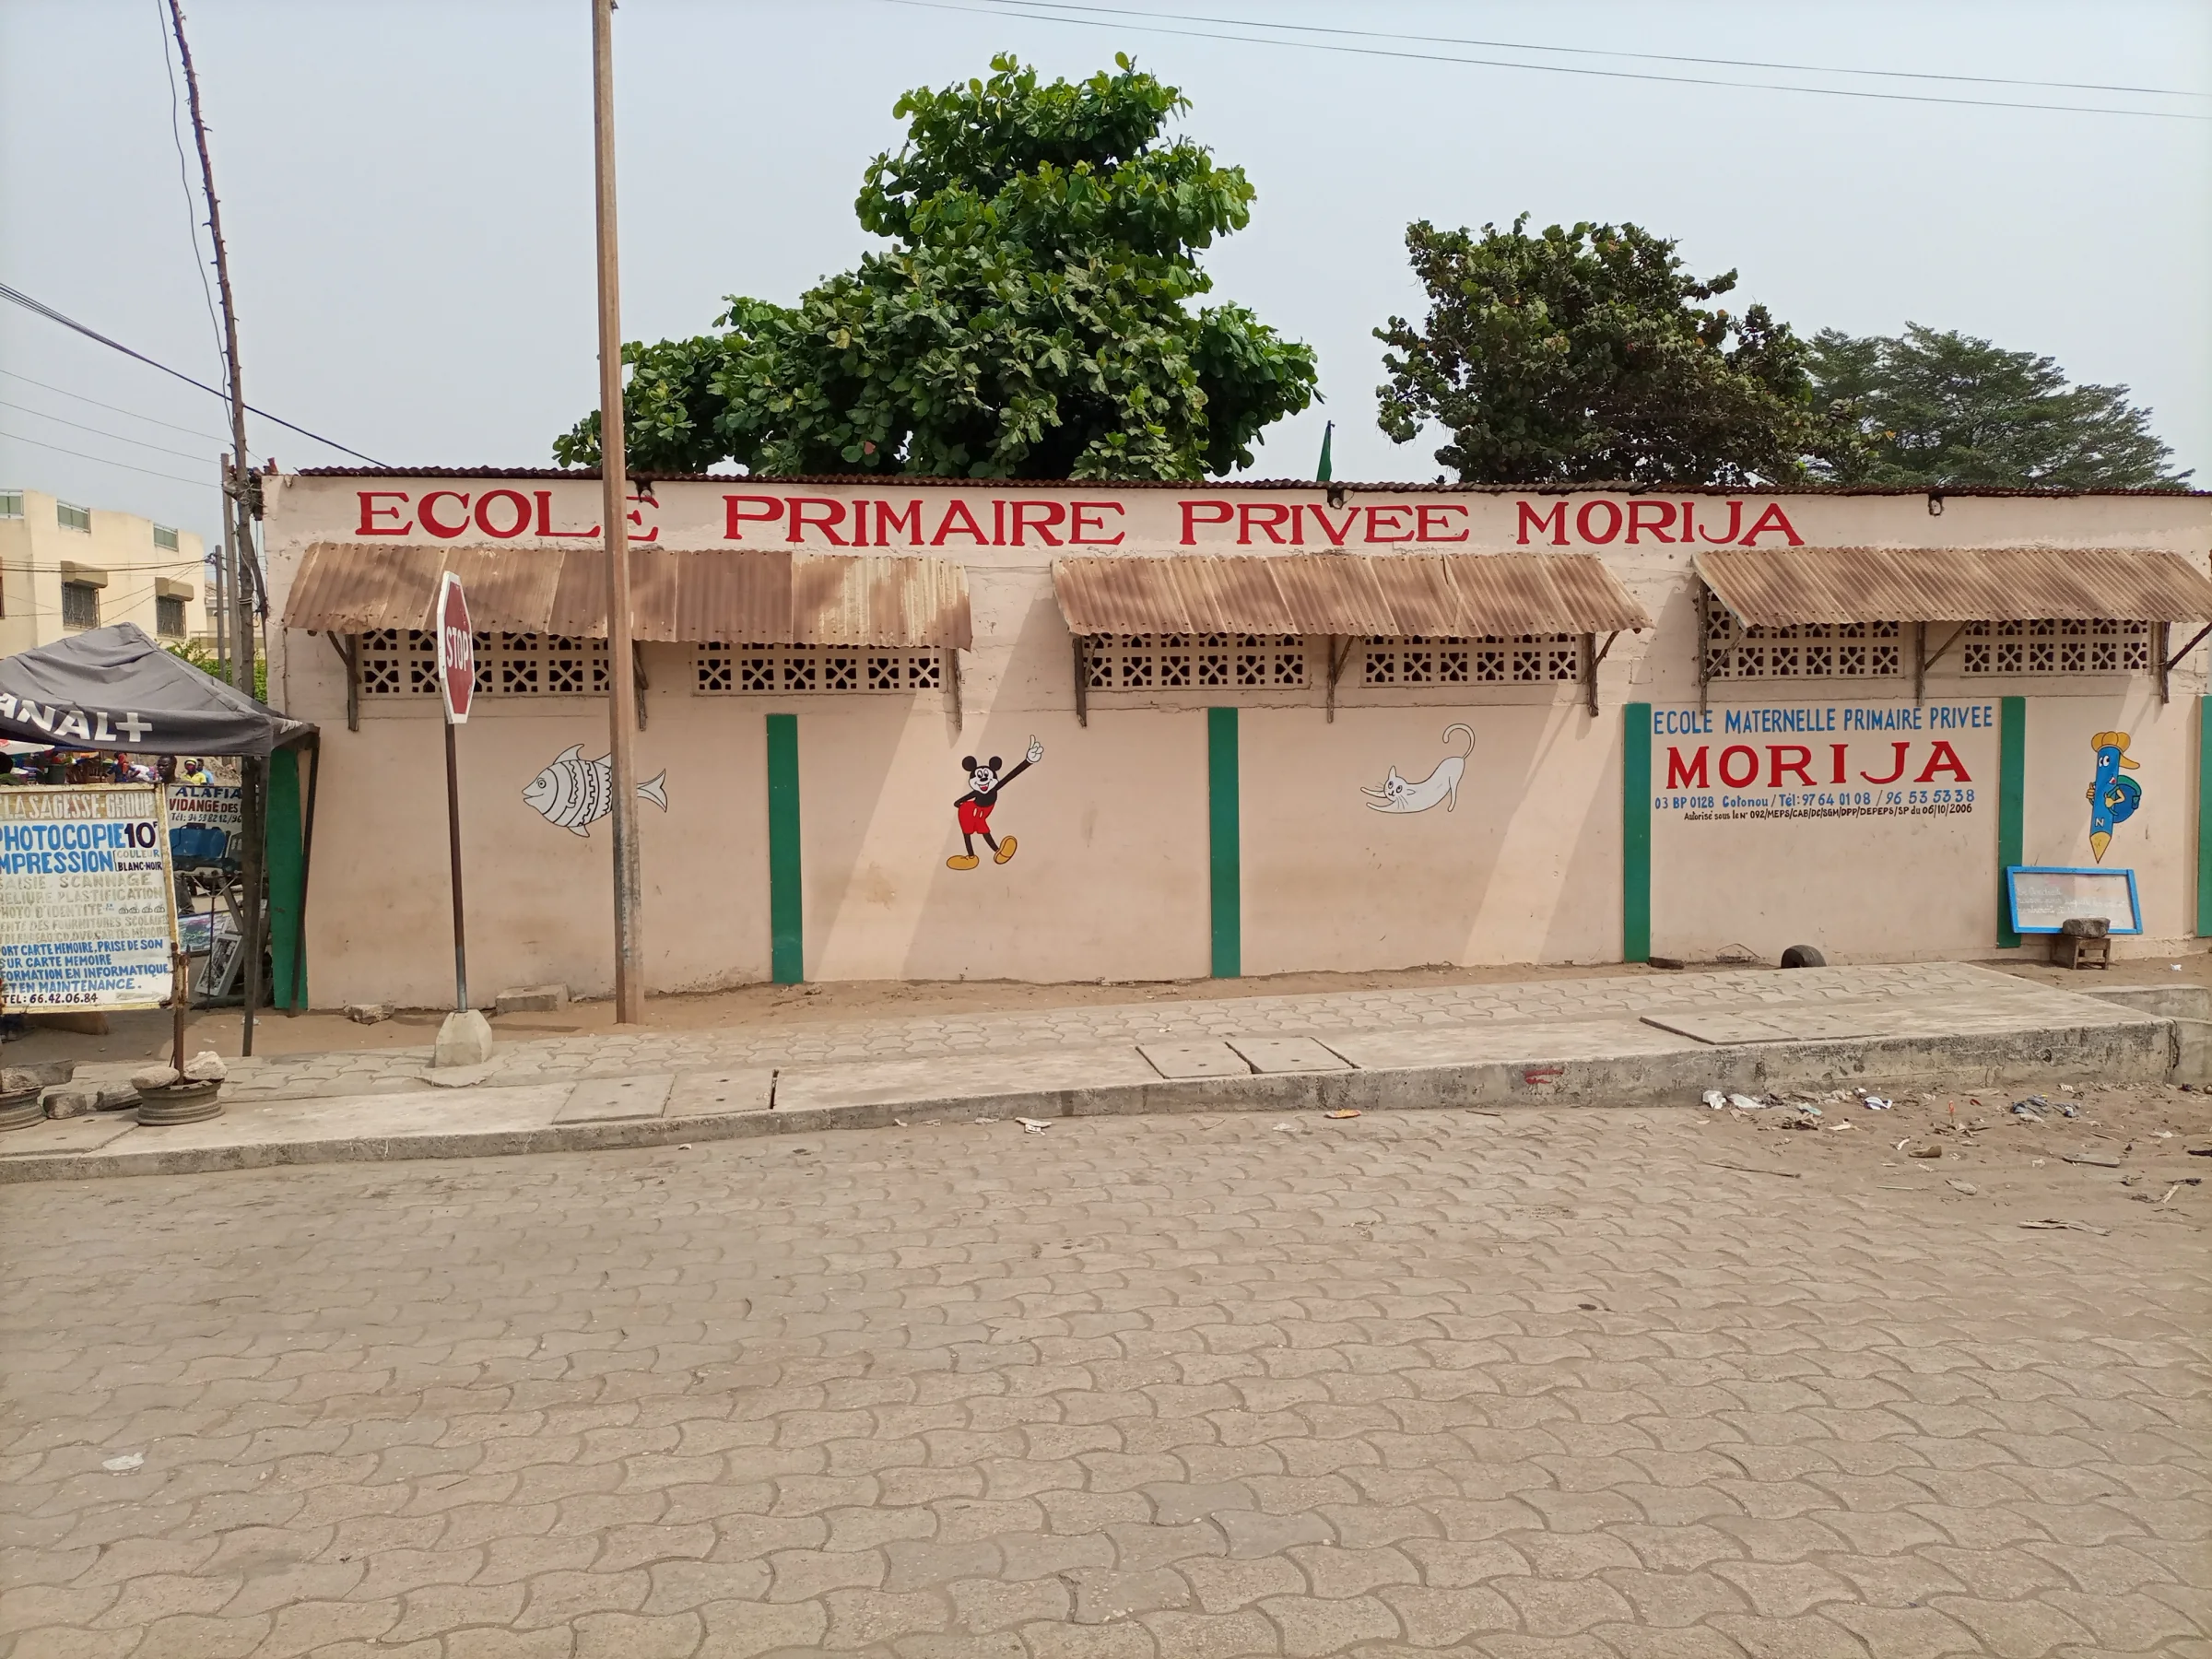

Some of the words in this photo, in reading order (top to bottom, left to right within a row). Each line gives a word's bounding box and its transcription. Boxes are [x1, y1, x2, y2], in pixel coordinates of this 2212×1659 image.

[356, 489, 659, 542] ECOLE
[723, 494, 1125, 547] PRIMAIRE
[1179, 500, 1470, 546] PRIVEE
[1516, 500, 1805, 547] MORIJA
[446, 626, 469, 672] STOP
[1653, 710, 1712, 735] ECOLE
[1725, 709, 1836, 734] MATERNELLE
[1844, 707, 1922, 731] PRIMAIRE
[1930, 706, 1993, 729] PRIVEE
[1666, 740, 1971, 790] MORIJA
[169, 798, 219, 812] VIDANGE
[221, 803, 239, 813] DES
[1654, 796, 1668, 809] 03
[1673, 797, 1687, 808] BP
[1689, 795, 1714, 808] 0128
[1722, 795, 1769, 807] Cotonou
[1779, 793, 1800, 806] Tél:
[1802, 794, 1816, 806] 97
[1818, 794, 1834, 806] 64
[1840, 793, 1850, 806] 01
[1854, 792, 1870, 805] 08
[1886, 791, 1902, 805] 96
[1909, 791, 1928, 804] 53
[1933, 789, 1951, 803] 53
[1955, 789, 1975, 802] 38
[1911, 806, 1921, 815] du
[1922, 804, 1972, 818] 06/10/2006
[0, 822, 126, 851] HOTOCOPIE
[60, 872, 152, 888] SCANNAGE
[57, 887, 163, 905] PLASTIFICATION
[0, 906, 30, 919] HOTO
[0, 946, 18, 956] ORT
[21, 943, 53, 956] CARTE
[98, 940, 125, 952] PRISE
[127, 939, 138, 951] DE
[140, 938, 163, 950] SON
[0, 957, 23, 969] SUR
[26, 956, 62, 968] CARTE
[65, 954, 112, 966] MEMOIRE
[0, 969, 63, 982] FORMATION
[65, 968, 80, 979] EN
[84, 963, 169, 979] INFORMATIQUE
[19, 982, 35, 994] EN
[29, 993, 99, 1004] 66.42.06.84
